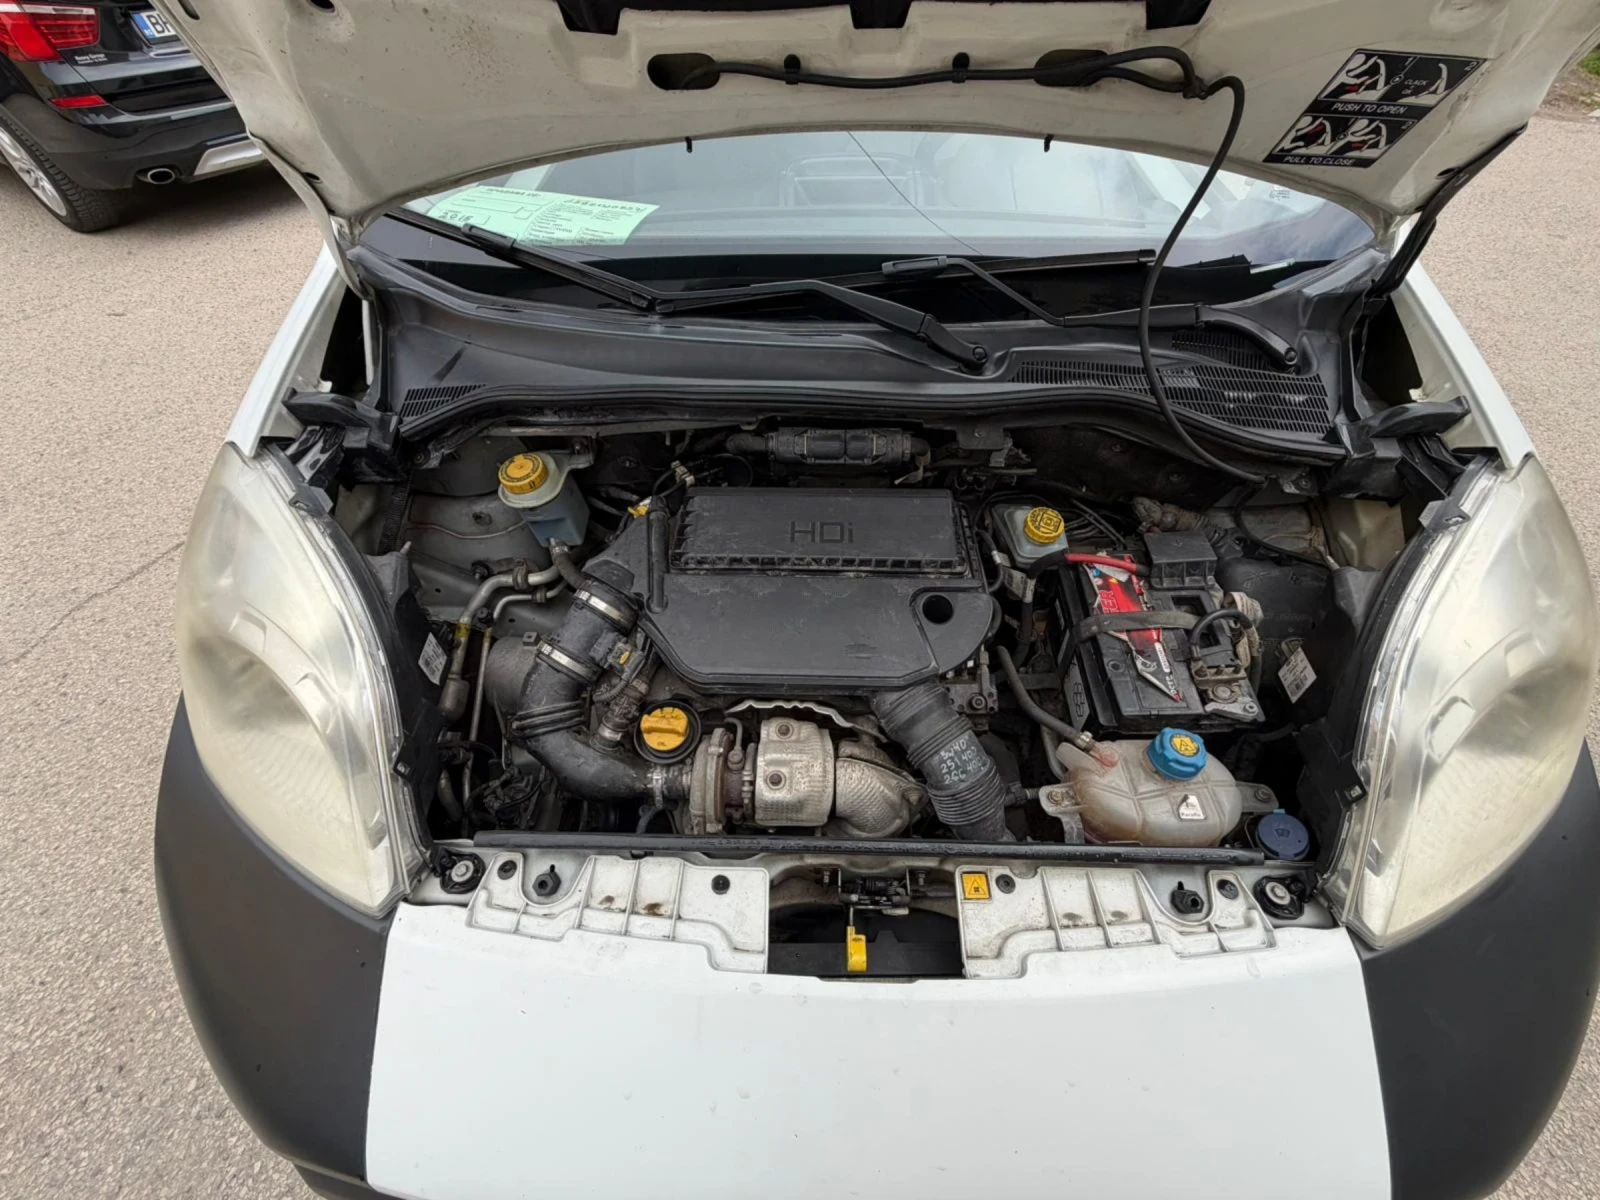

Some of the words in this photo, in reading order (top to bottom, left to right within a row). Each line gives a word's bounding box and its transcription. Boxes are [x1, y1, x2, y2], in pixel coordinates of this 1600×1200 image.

[1464, 61, 1477, 71] 2
[1332, 103, 1360, 112] PUSH
[1361, 104, 1376, 113] TO
[1377, 105, 1408, 114] OPEN
[1282, 155, 1307, 164] PULL
[1309, 157, 1322, 165] TO
[1322, 157, 1357, 166] CLOSE
[790, 521, 854, 544] HDi
